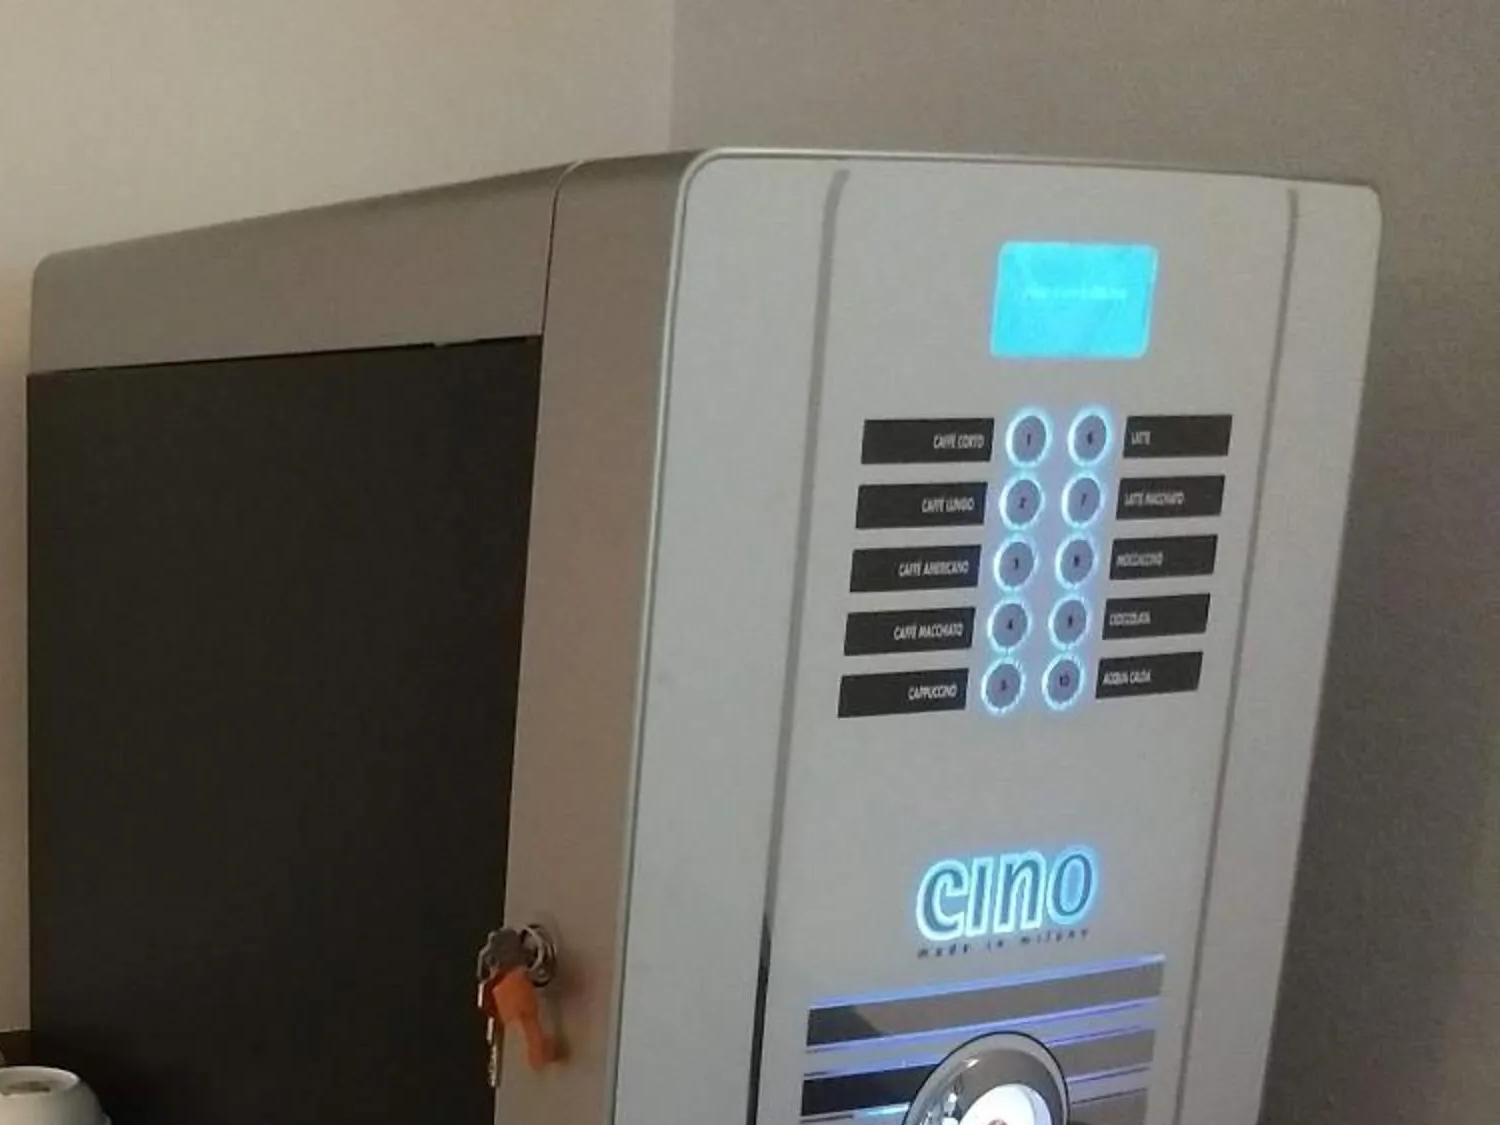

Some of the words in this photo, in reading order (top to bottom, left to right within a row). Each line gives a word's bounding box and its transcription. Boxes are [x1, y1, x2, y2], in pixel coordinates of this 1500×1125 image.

[958, 433, 985, 449] CORTO
[1131, 430, 1151, 445] LATTE
[946, 497, 975, 512] LUNGO
[923, 560, 970, 576] AMERICANO
[918, 623, 964, 639] MACCHIATO
[1102, 670, 1129, 686] ACQUA
[908, 683, 958, 701] CAPPUCCINO
